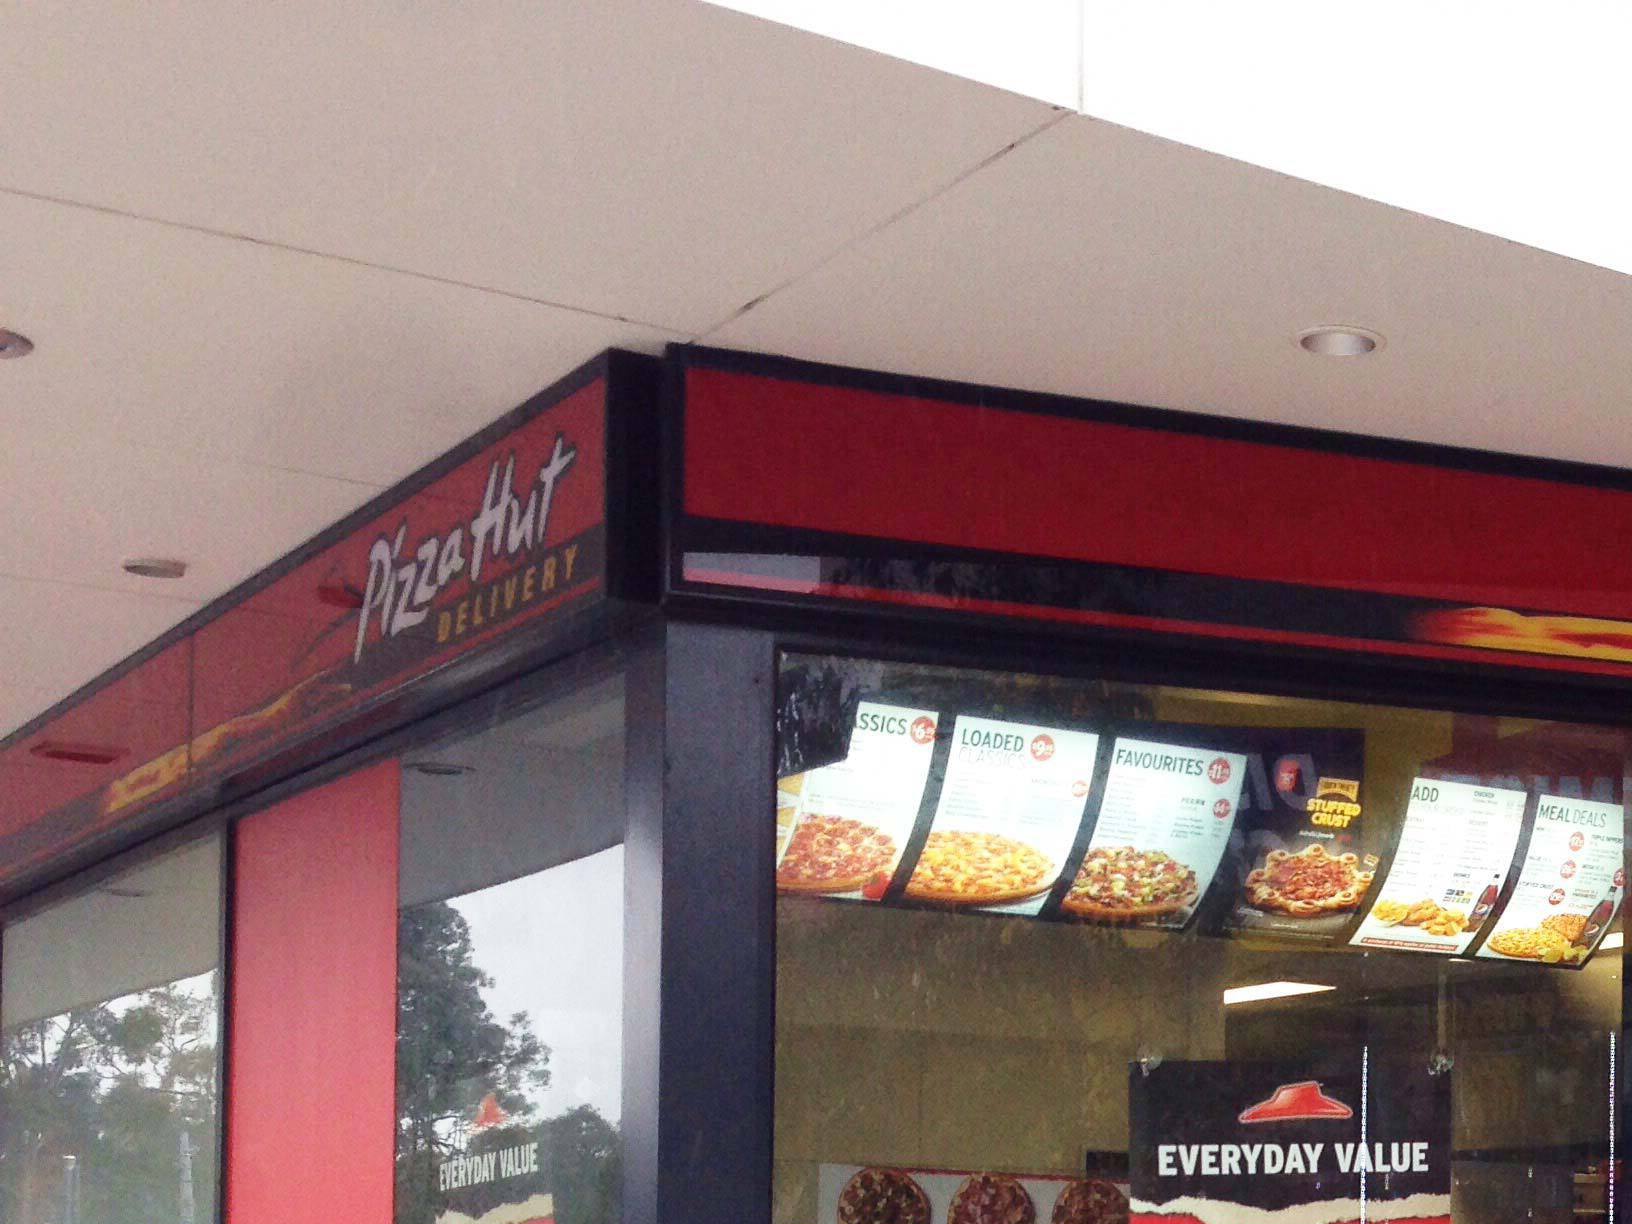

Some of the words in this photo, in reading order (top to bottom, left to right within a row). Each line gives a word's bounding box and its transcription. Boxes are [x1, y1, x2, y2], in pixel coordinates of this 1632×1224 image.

[354, 524, 466, 664] Pizza
[470, 437, 577, 582] Hut
[437, 545, 578, 643] DELIVERY
[961, 728, 1025, 753] LOADED
[1115, 749, 1205, 776] FAVOURITES
[1411, 785, 1439, 803] ADD
[1306, 798, 1361, 818] STUFFED
[1311, 814, 1352, 828] CRUST
[1538, 804, 1571, 823] MEAL
[1572, 808, 1607, 828] DEALS
[439, 1151, 498, 1192] EVERYDAY
[499, 1142, 539, 1180] VALUE
[1158, 1143, 1324, 1176] EVERYDAY
[1334, 1142, 1429, 1173] VALUE
